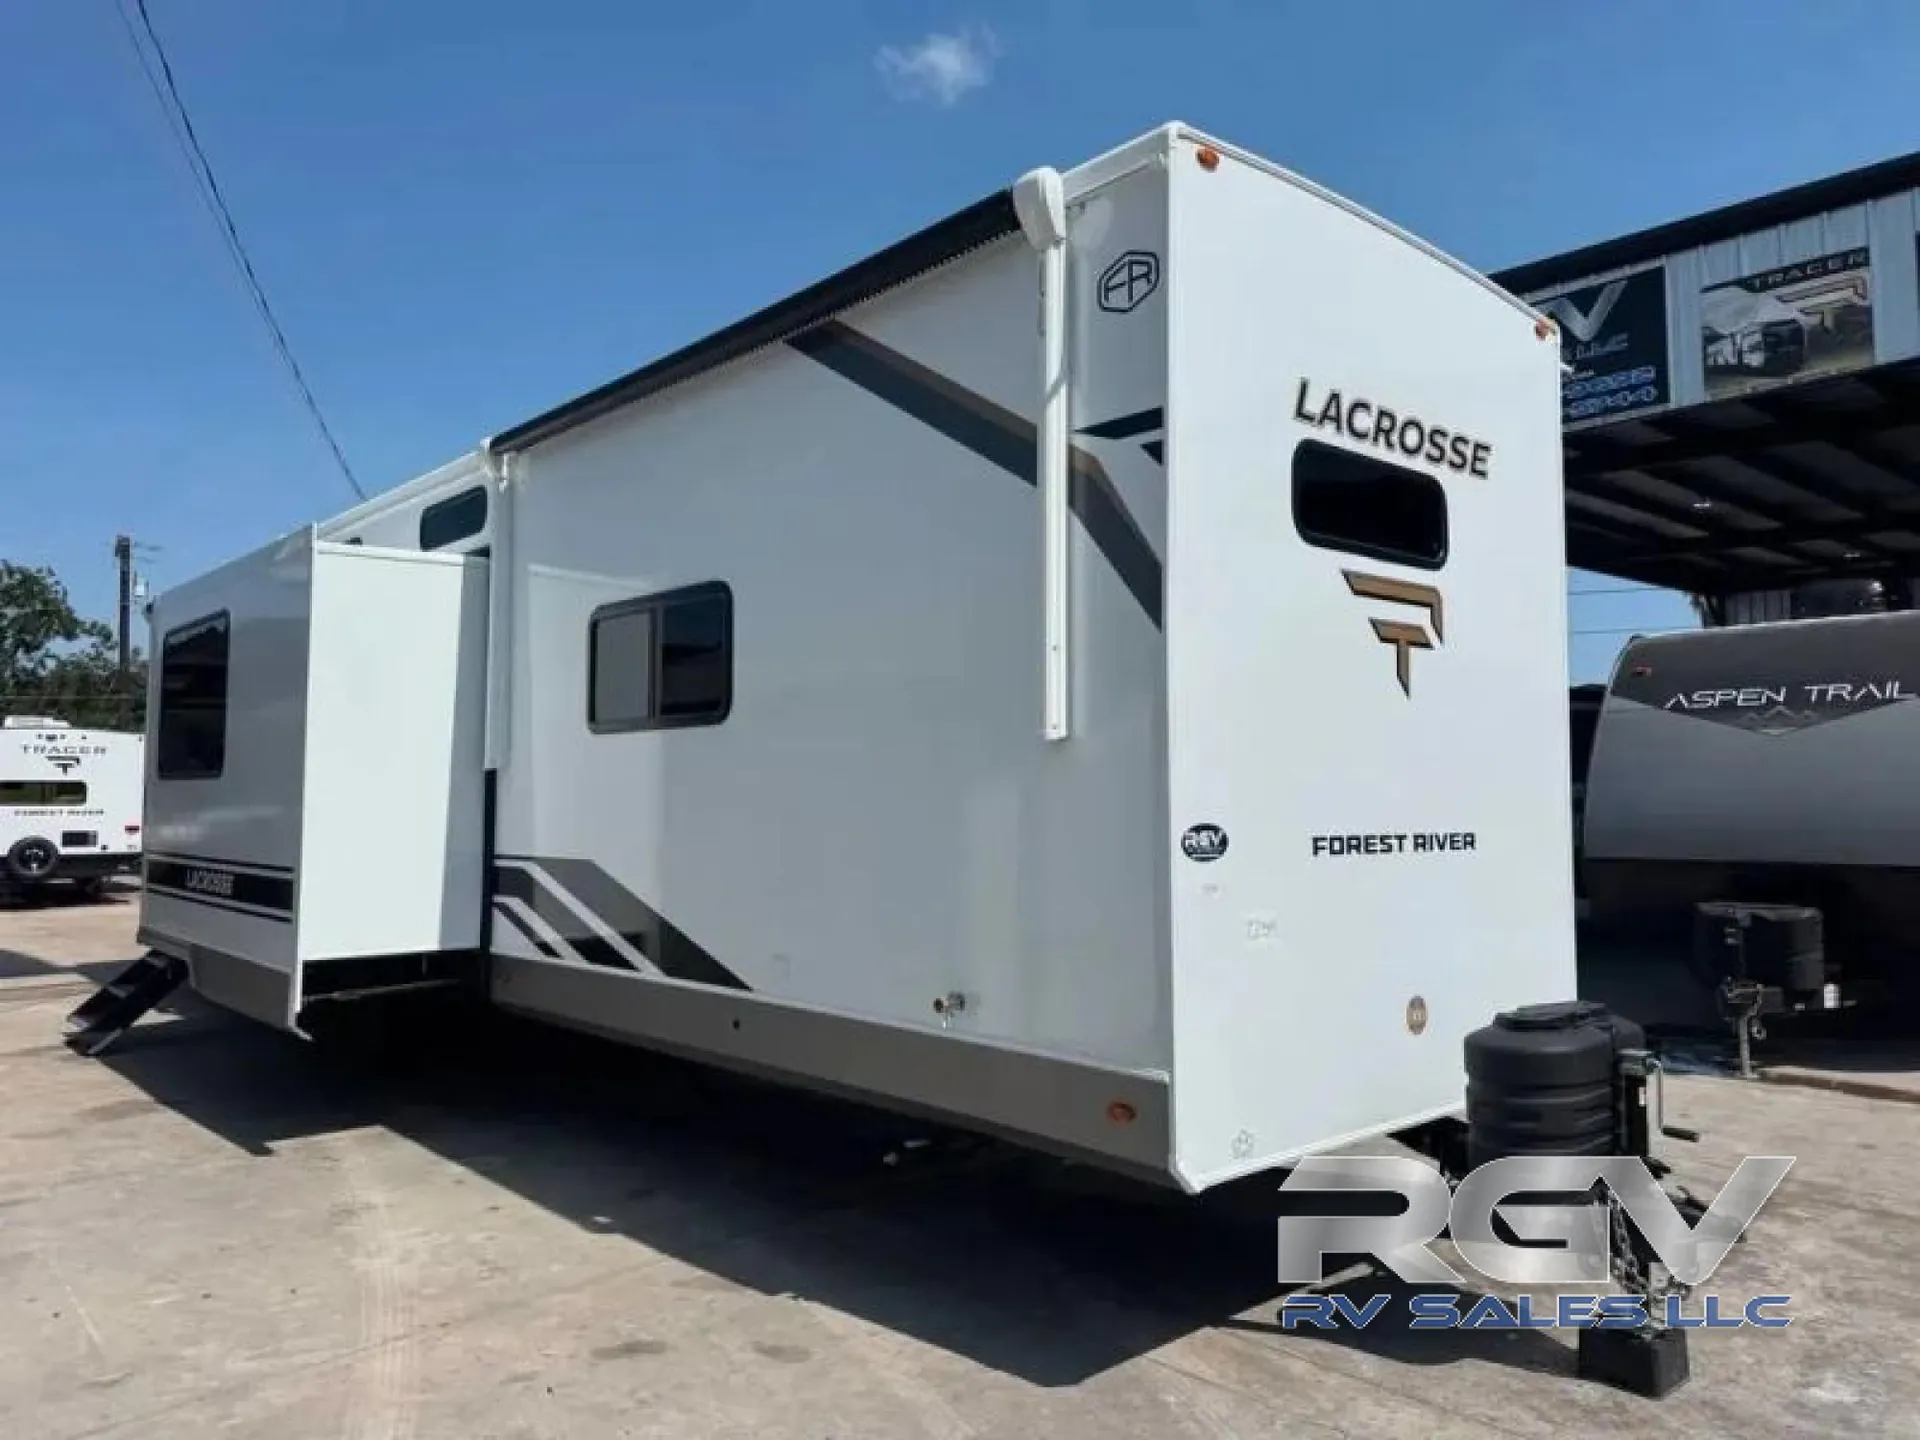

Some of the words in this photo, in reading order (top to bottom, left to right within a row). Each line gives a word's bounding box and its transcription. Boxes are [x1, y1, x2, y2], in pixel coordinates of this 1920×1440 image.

[1747, 249, 1867, 289] TRACER
[1292, 377, 1494, 480] LACROSSE
[1664, 686, 1787, 710] ASPEN
[1804, 680, 1916, 702] TRAIL
[20, 743, 108, 755] TRACER
[1311, 834, 1408, 857] FOREST
[1413, 832, 1477, 853] RIVER
